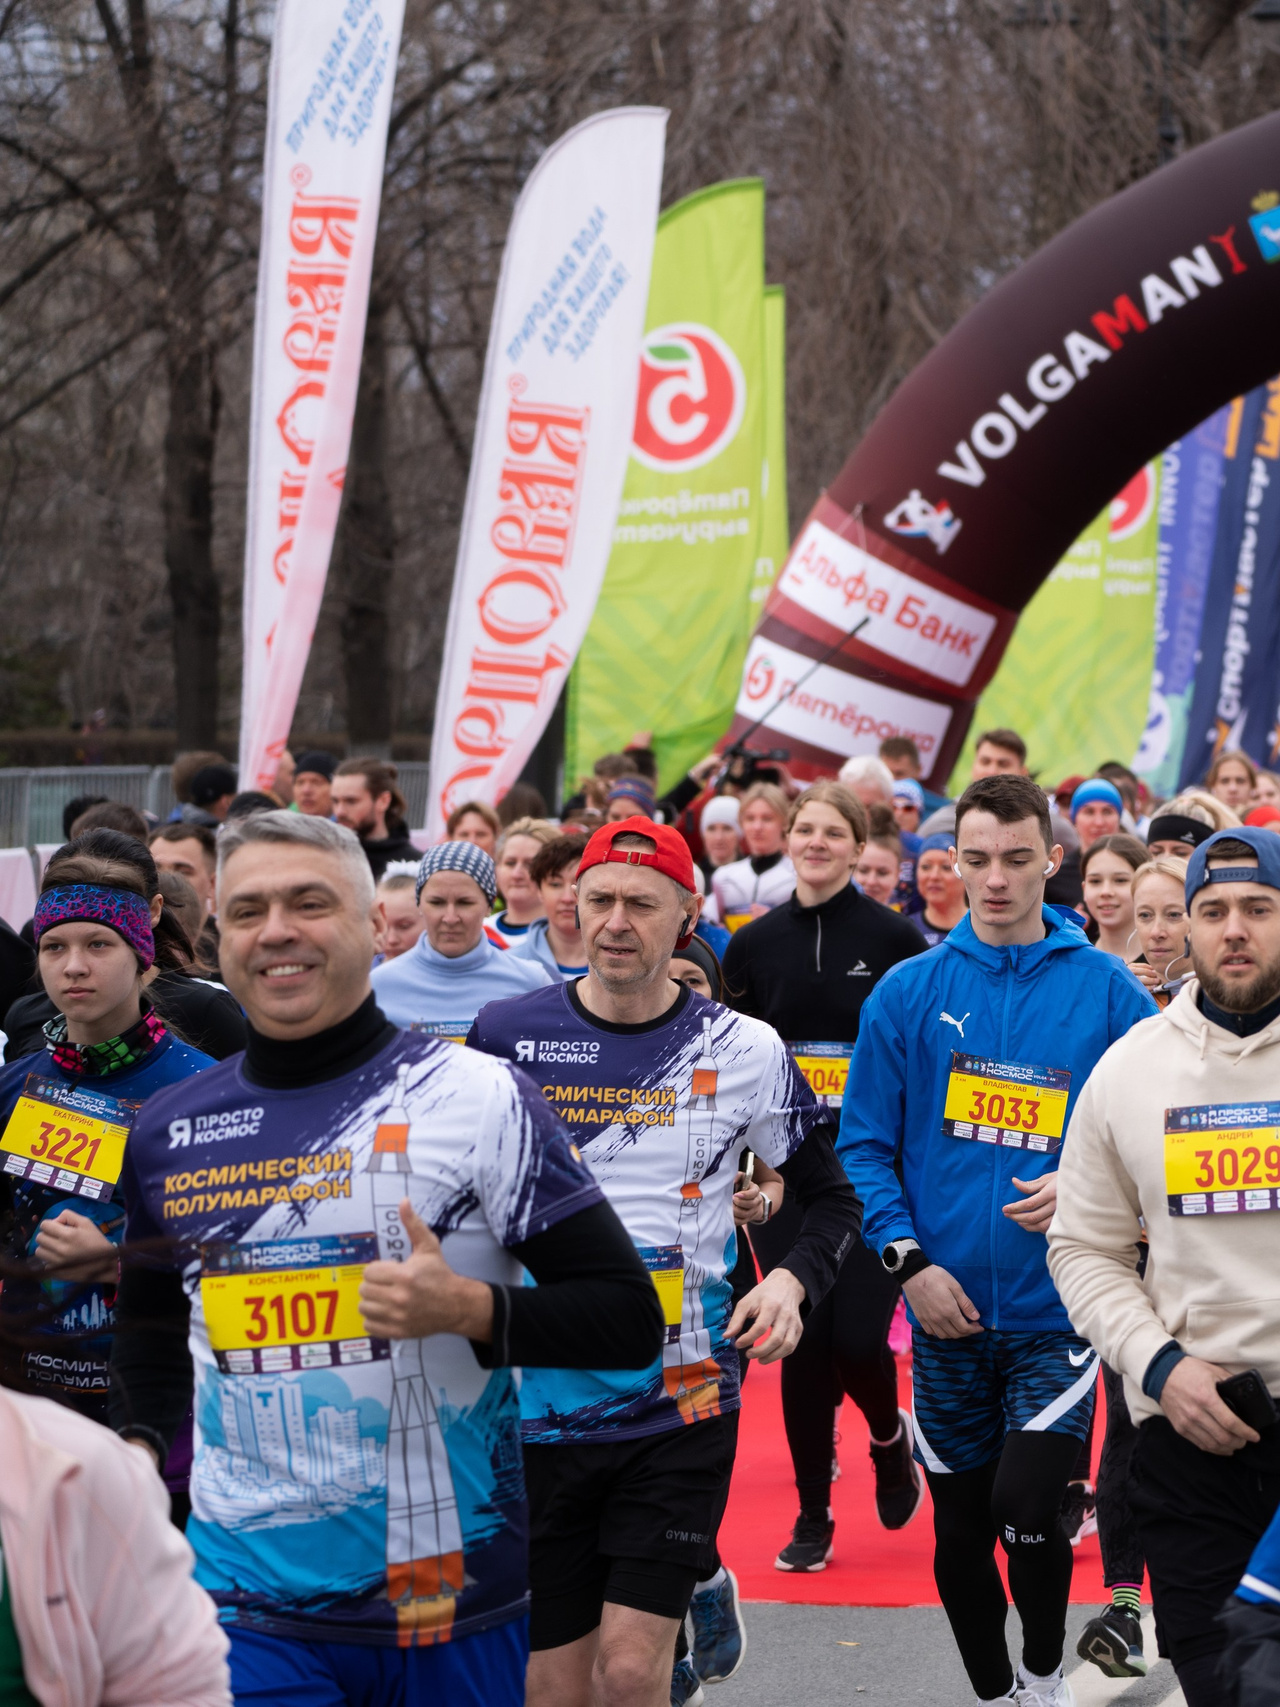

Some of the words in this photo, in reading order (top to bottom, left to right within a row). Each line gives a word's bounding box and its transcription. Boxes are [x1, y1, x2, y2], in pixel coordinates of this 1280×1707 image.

[937, 243, 1223, 490] VOLGAMAN
[798, 538, 891, 617] Альфа
[893, 593, 981, 659] Банк
[515, 1040, 536, 1062] Я
[539, 1041, 600, 1052] ПРОСТО
[538, 1052, 599, 1064] КОСМОС
[986, 1067, 1033, 1081] КОСМОС
[995, 1063, 1034, 1075] ПРОСТО
[541, 1085, 677, 1106] СМИЧЕСКИЙ
[982, 1080, 1028, 1093] ВЛАДИСЛАВ
[53, 1109, 95, 1128] ЕКАТЕРИНА
[557, 1107, 675, 1127] УМАРАФОН
[968, 1090, 1041, 1130] 3033
[1208, 1114, 1269, 1125] КОСМОС
[1218, 1107, 1268, 1117] ПРОСТО
[168, 1118, 192, 1150] Я
[195, 1107, 264, 1131] ПРОСТО
[194, 1121, 261, 1145] КОСМОС
[1217, 1130, 1254, 1141] АНДРЕЙ
[30, 1121, 102, 1172] 3221
[692, 1138, 705, 1180] СОЮЗ
[164, 1147, 353, 1195] КОСМИЧЕСКИЙ
[163, 1178, 352, 1220] ПОЛУМАРАФОН
[248, 1271, 321, 1287] КОНСТАНТИН
[244, 1289, 339, 1342] 3107
[27, 1352, 108, 1373] КОСМИЧ
[27, 1368, 111, 1388] ПОЛУМА
[665, 1529, 689, 1542] GYM
